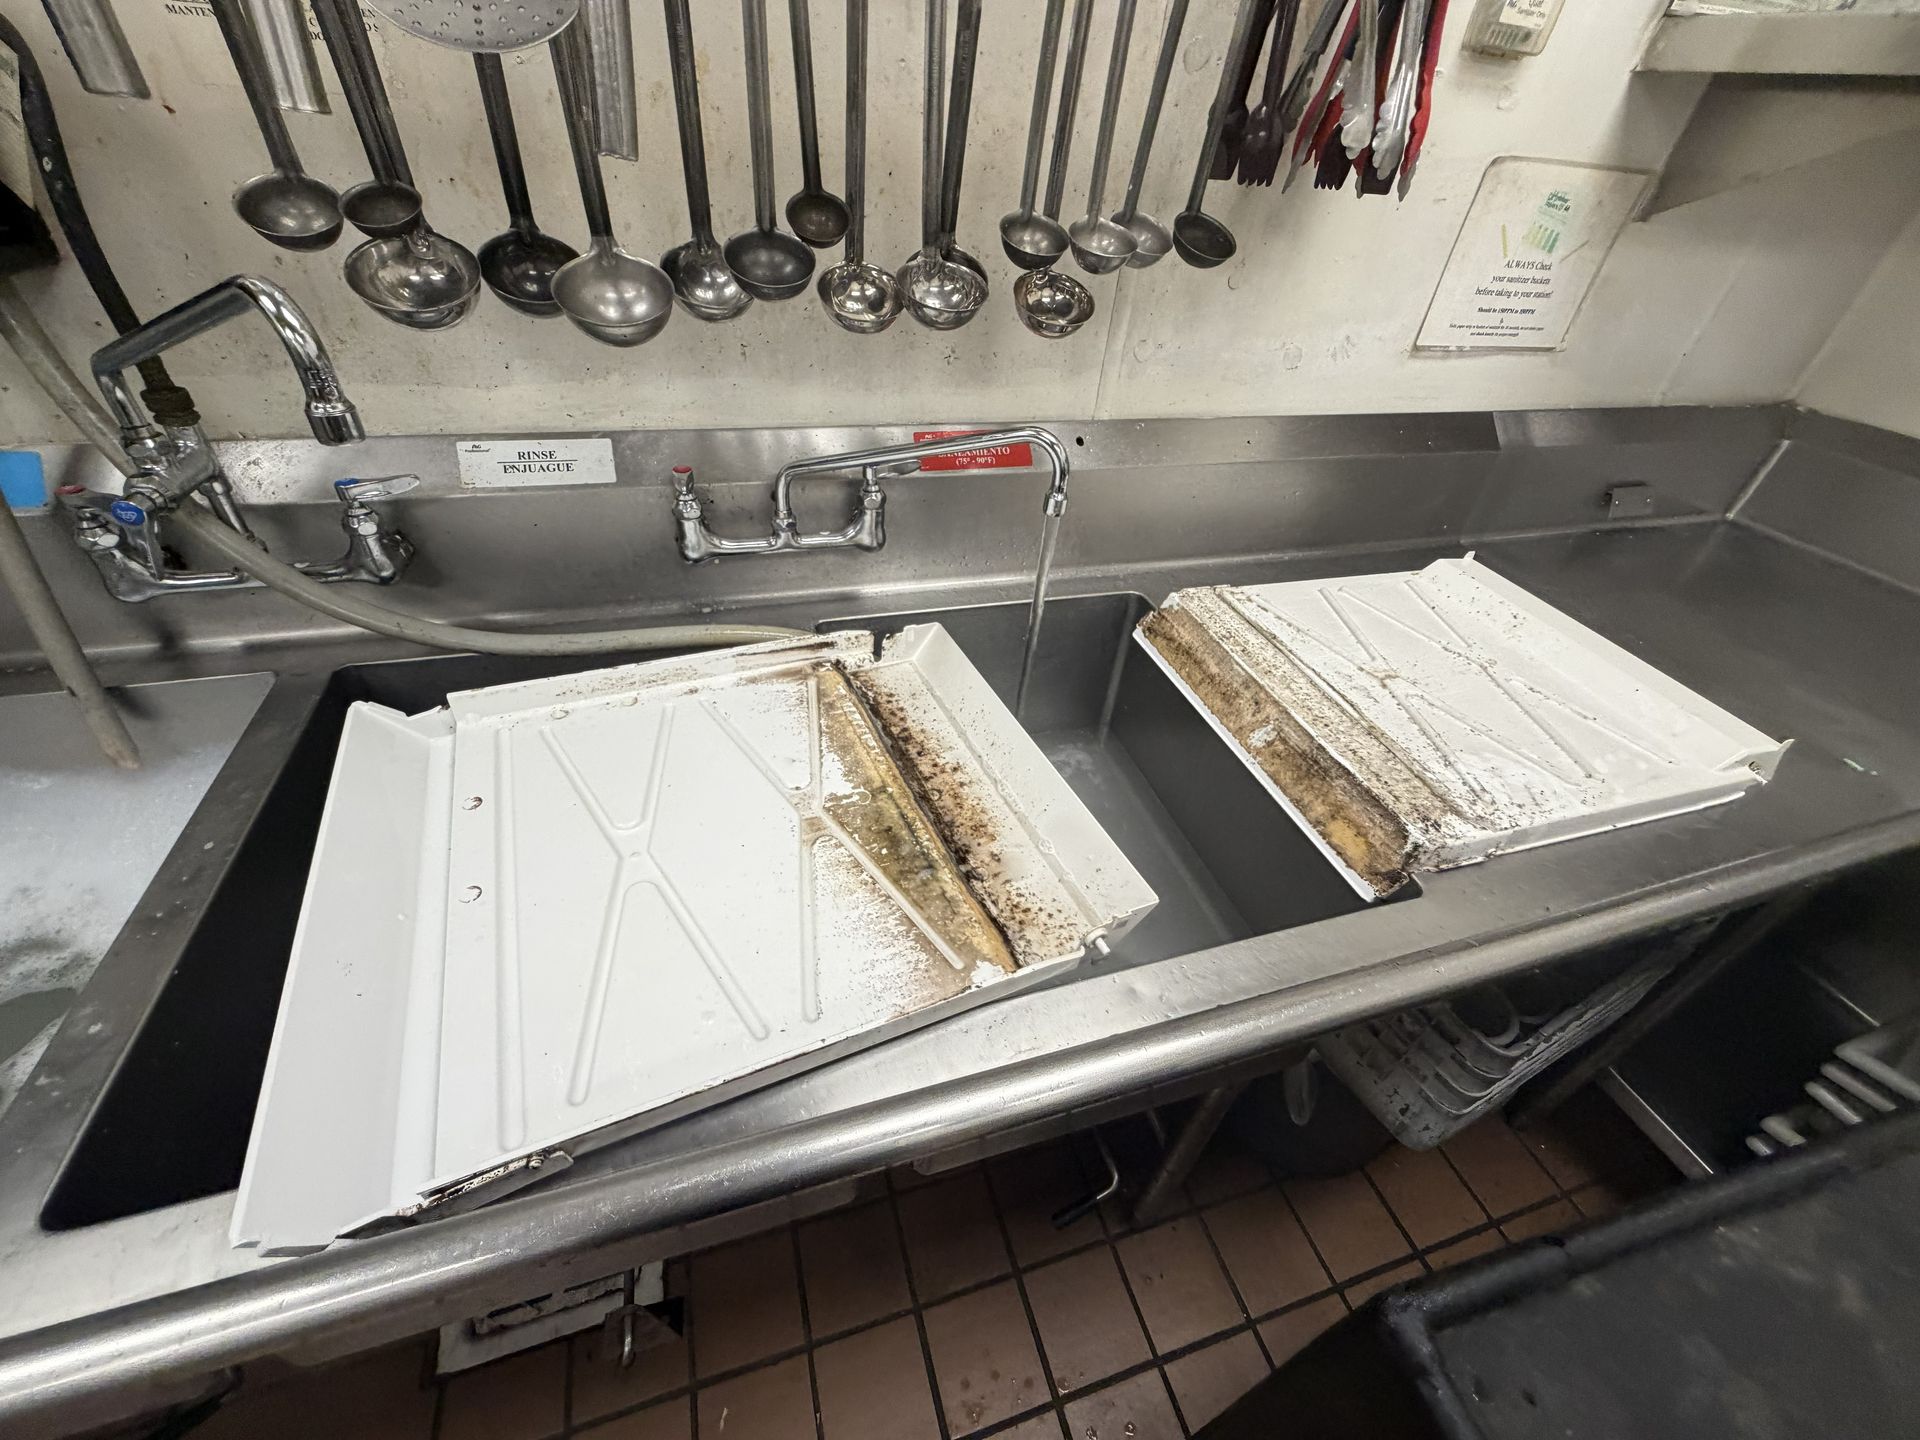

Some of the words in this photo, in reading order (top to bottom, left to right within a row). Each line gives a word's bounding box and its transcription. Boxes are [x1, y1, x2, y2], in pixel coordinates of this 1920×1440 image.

[1504, 260, 1535, 269] ALWAYS
[1475, 285, 1495, 296] before
[517, 450, 557, 461] RINSE
[503, 462, 575, 474] ENJUAGUE
